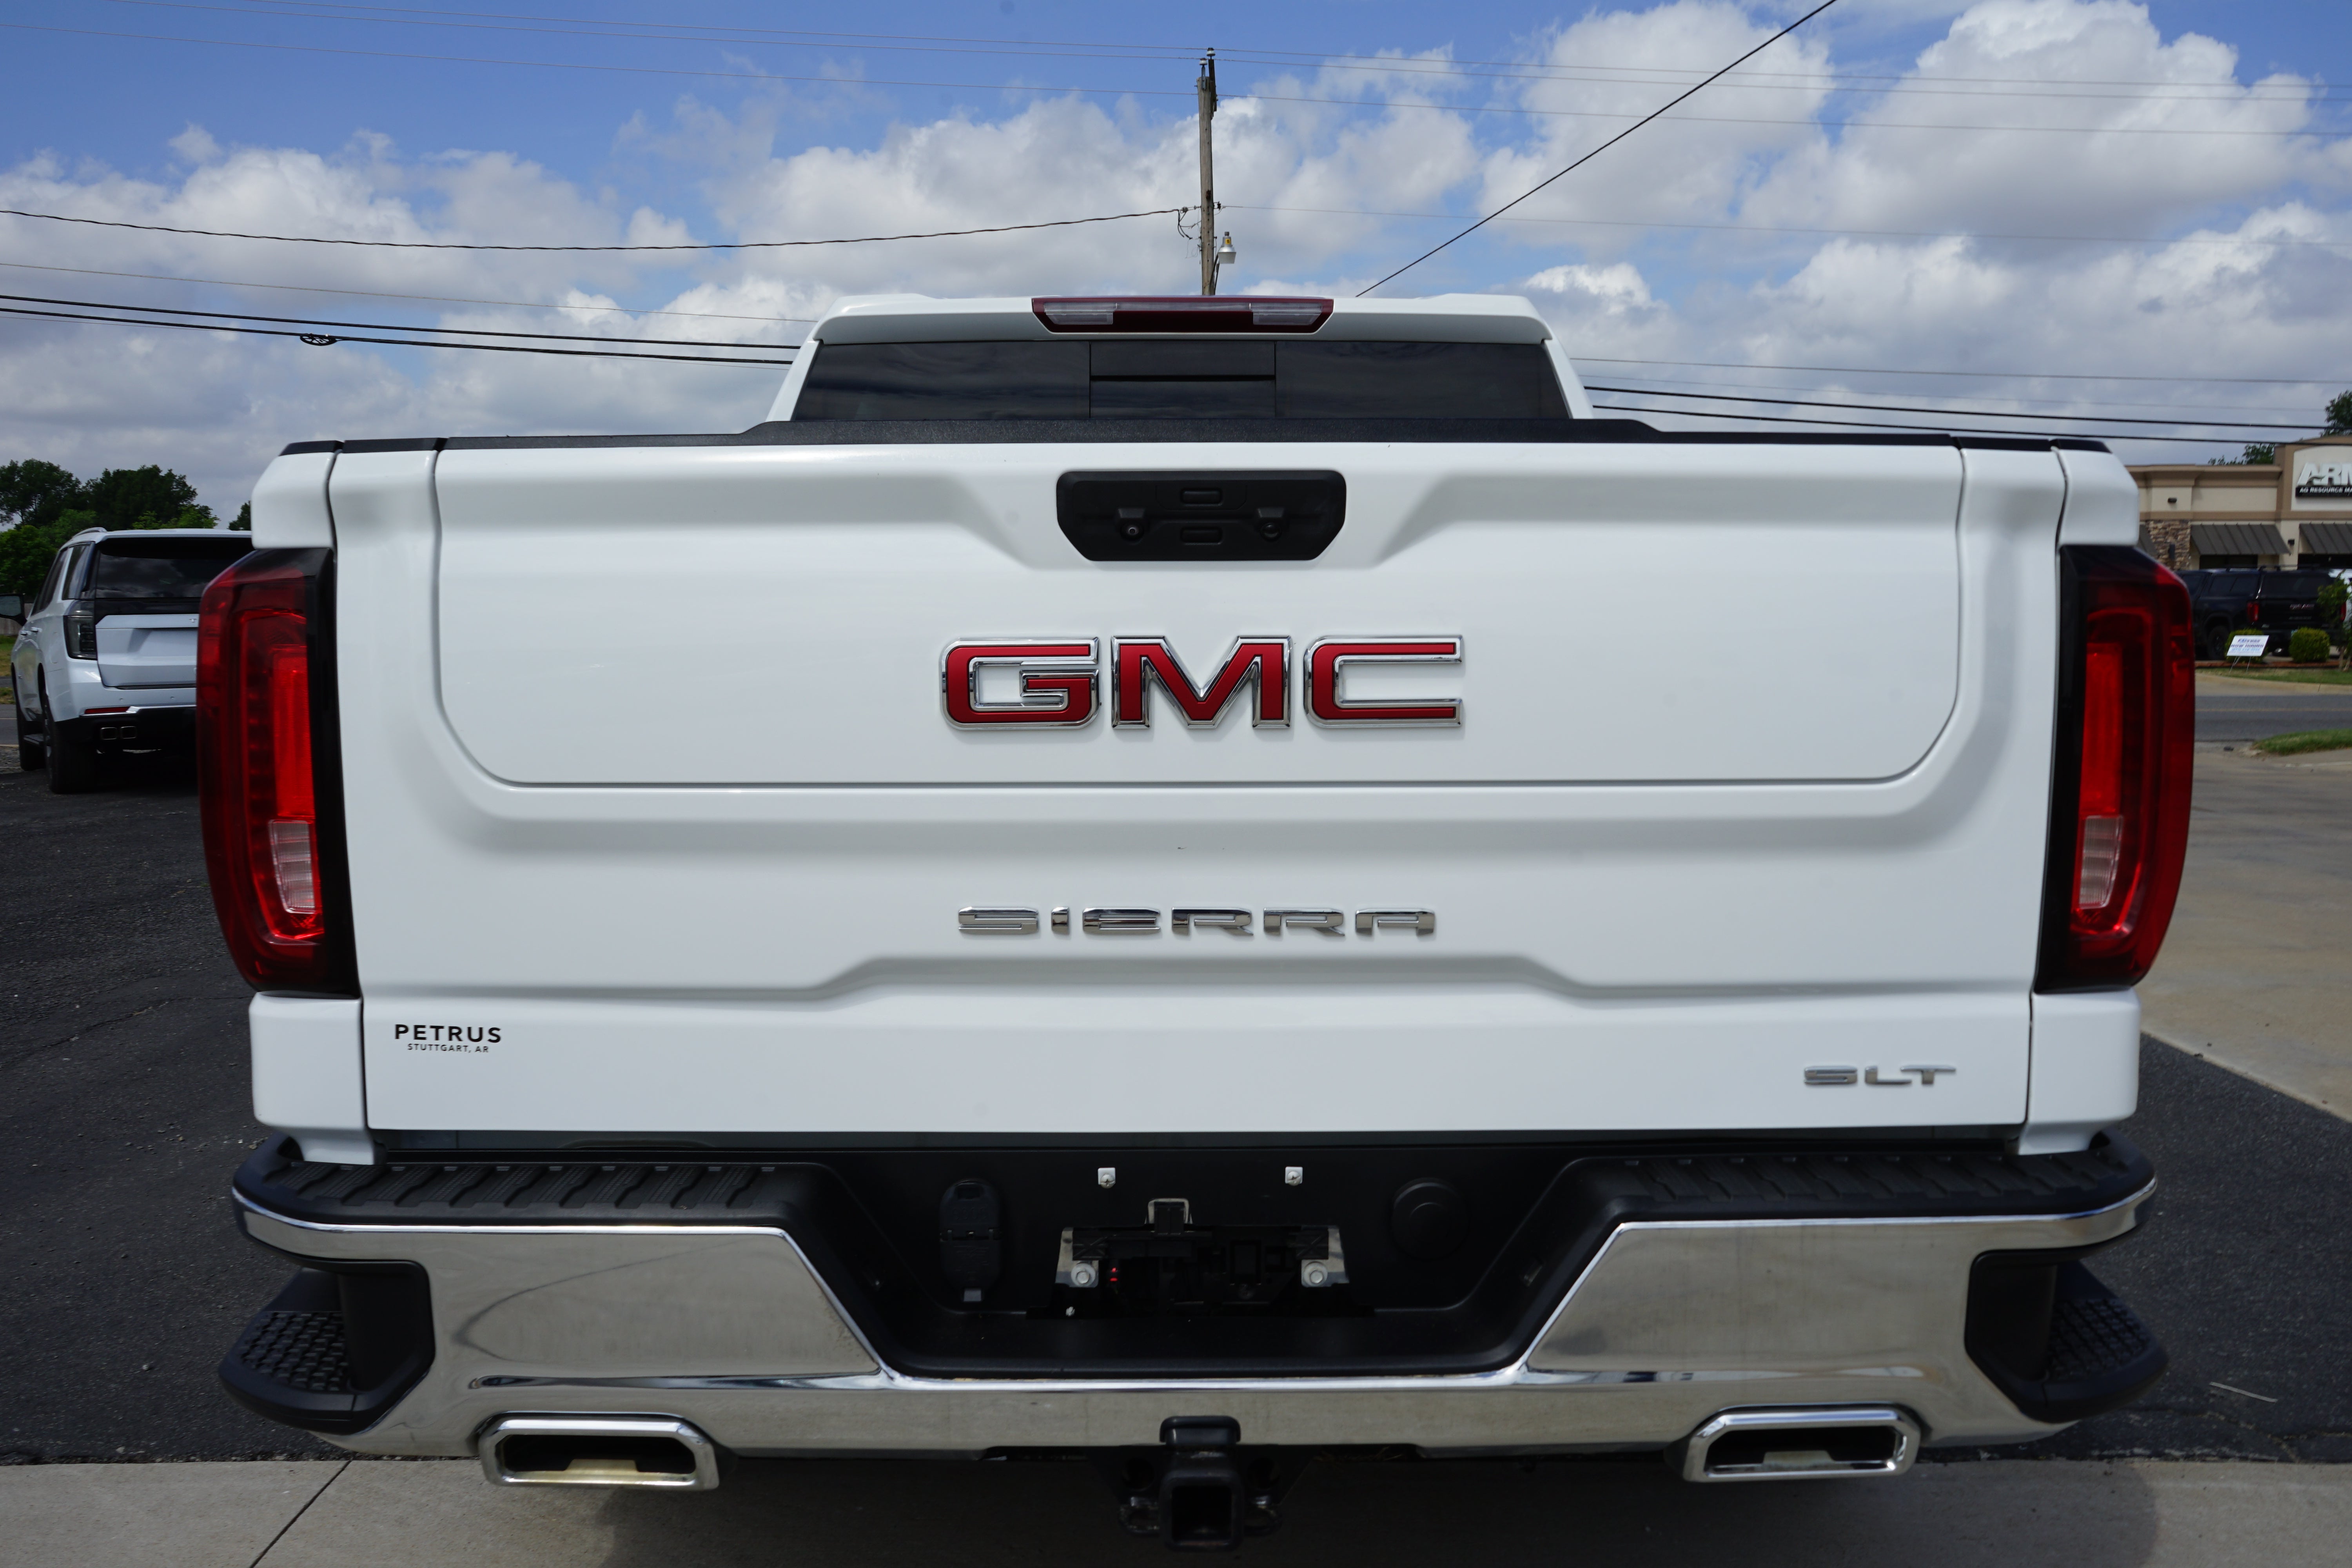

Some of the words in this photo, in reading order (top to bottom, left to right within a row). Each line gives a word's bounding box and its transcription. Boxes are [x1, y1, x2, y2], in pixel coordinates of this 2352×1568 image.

[941, 635, 1463, 730] GMC
[395, 1024, 501, 1043] PETRUS
[408, 1044, 471, 1053] STUTTGART,
[1804, 1065, 1956, 1085] SLT
